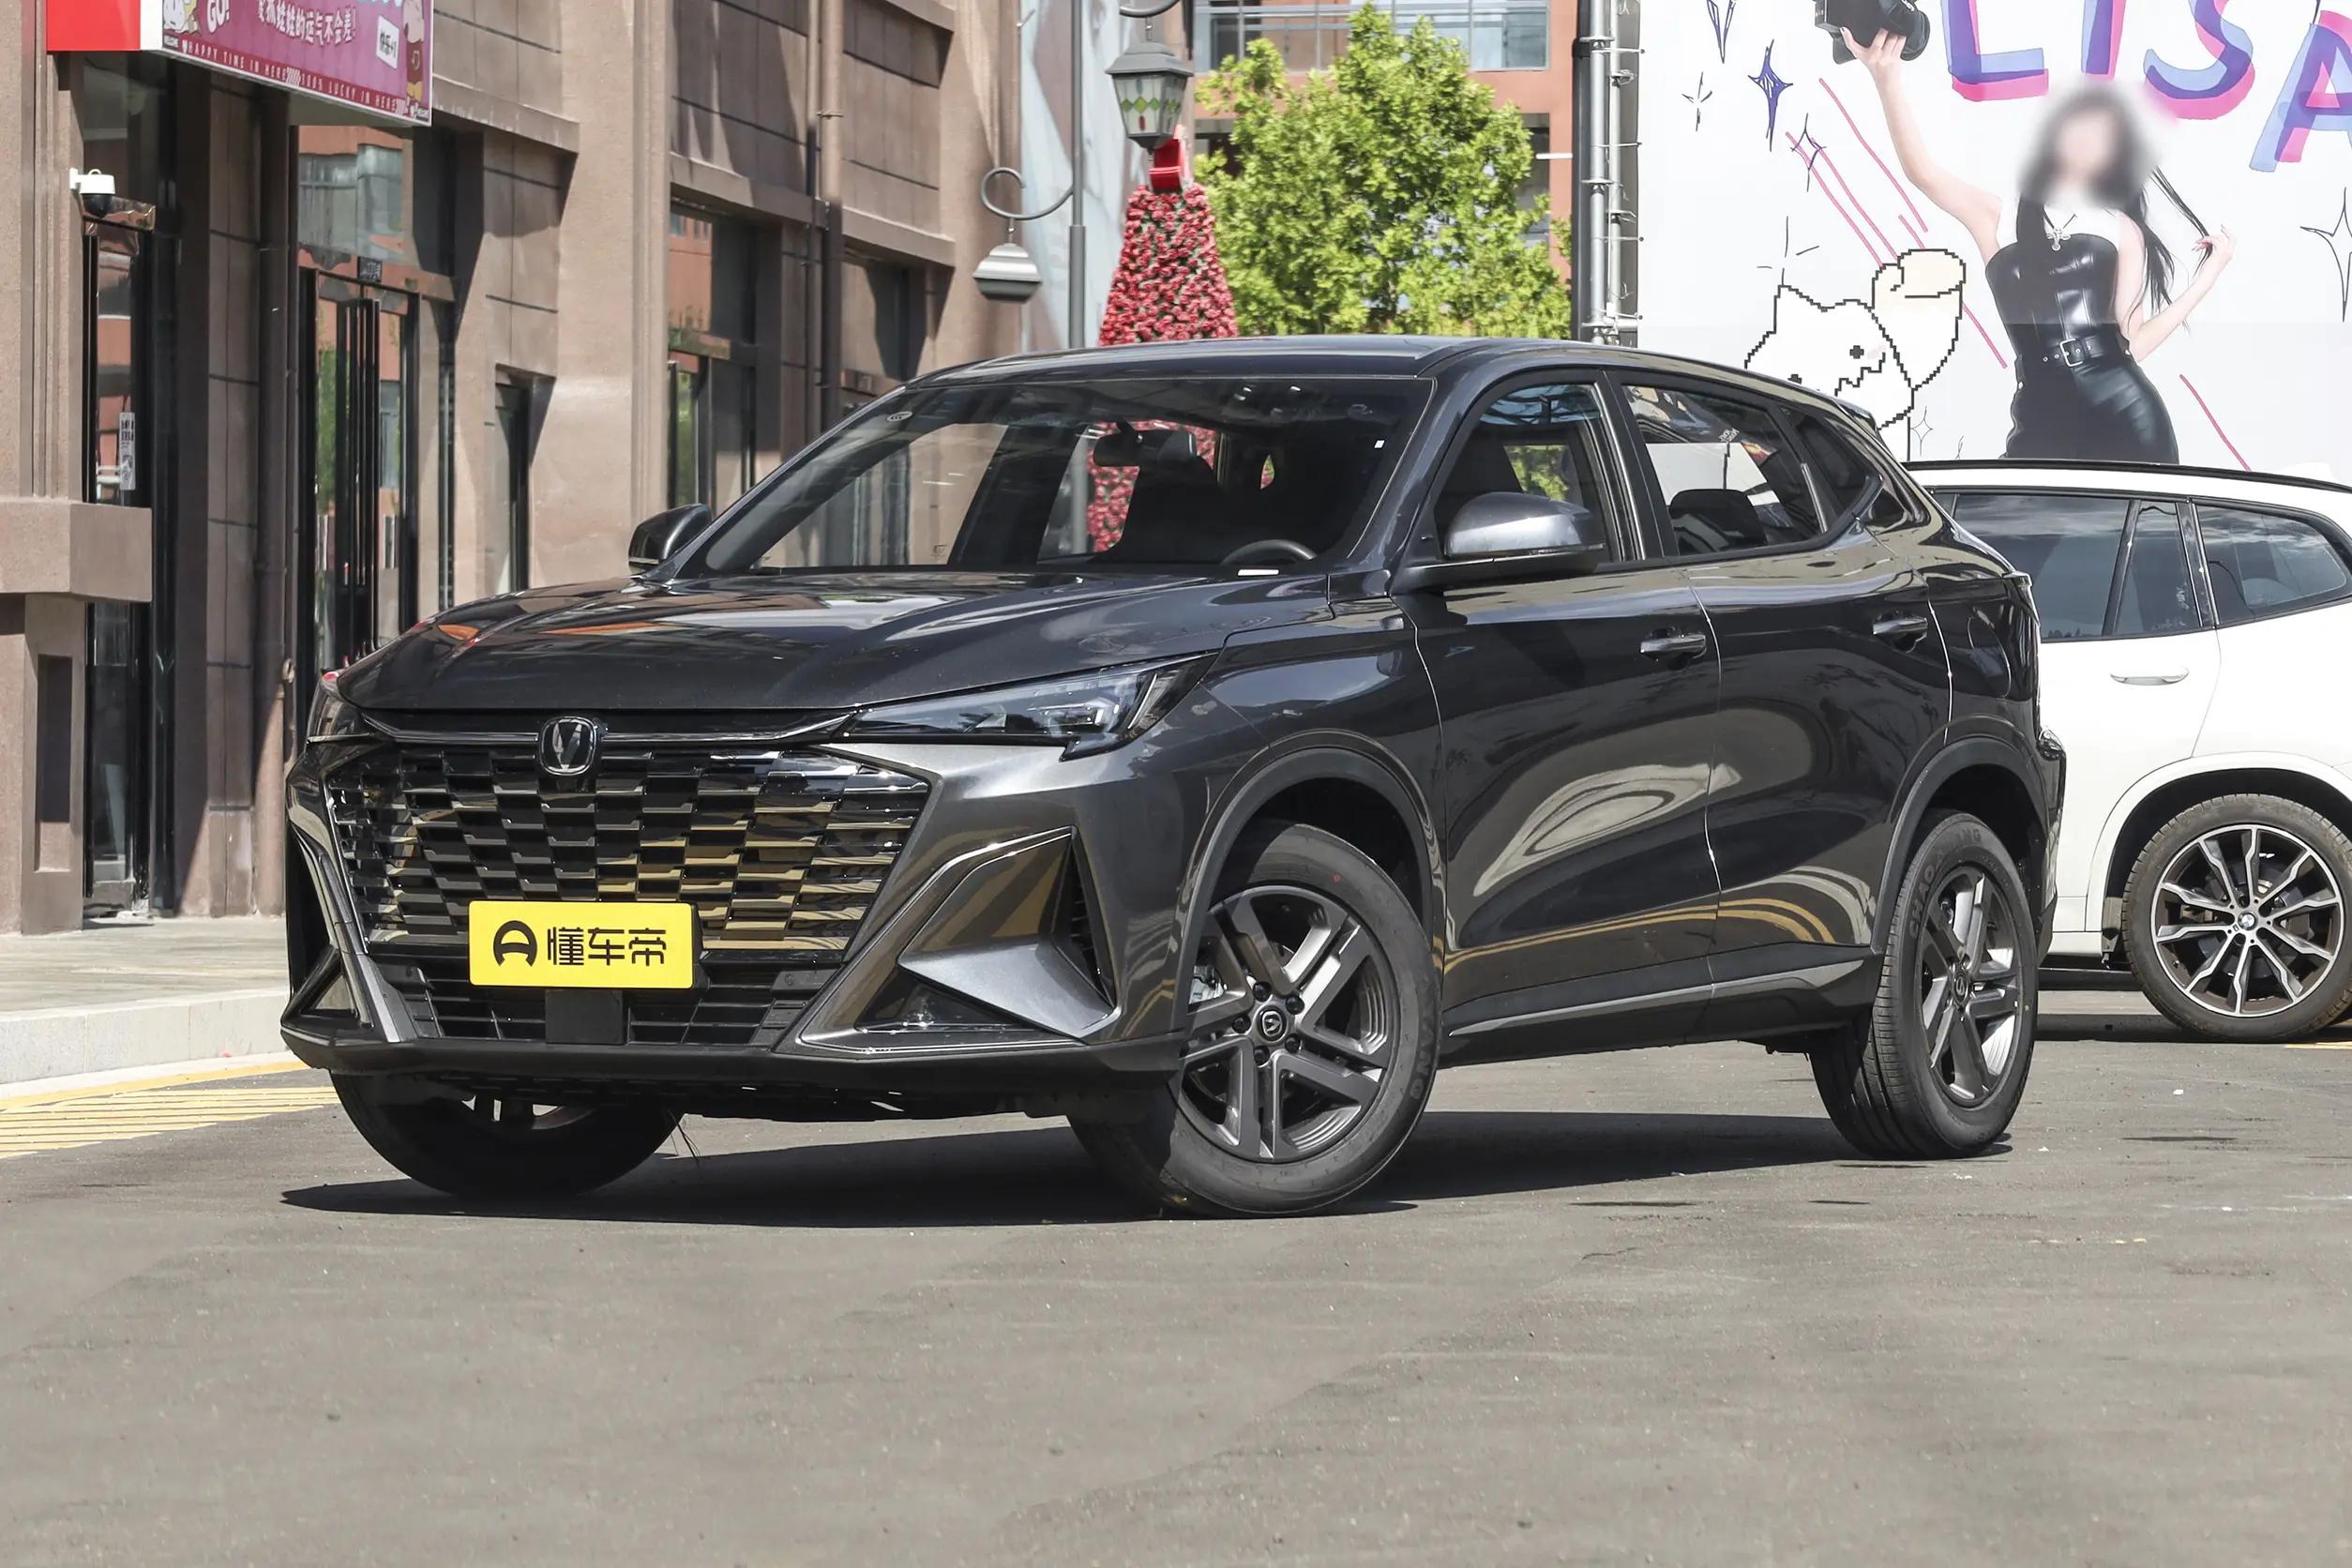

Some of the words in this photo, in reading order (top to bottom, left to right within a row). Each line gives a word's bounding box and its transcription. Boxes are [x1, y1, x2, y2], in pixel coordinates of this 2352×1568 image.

[188, 41, 218, 61] HAPPY
[224, 52, 245, 68] TIME
[250, 60, 260, 72] IN
[264, 65, 287, 81] HERE
[329, 82, 355, 98] LUCKY
[375, 95, 396, 111] HERE
[1940, 0, 2352, 173] LISA
[547, 926, 668, 967] 懂车帝
